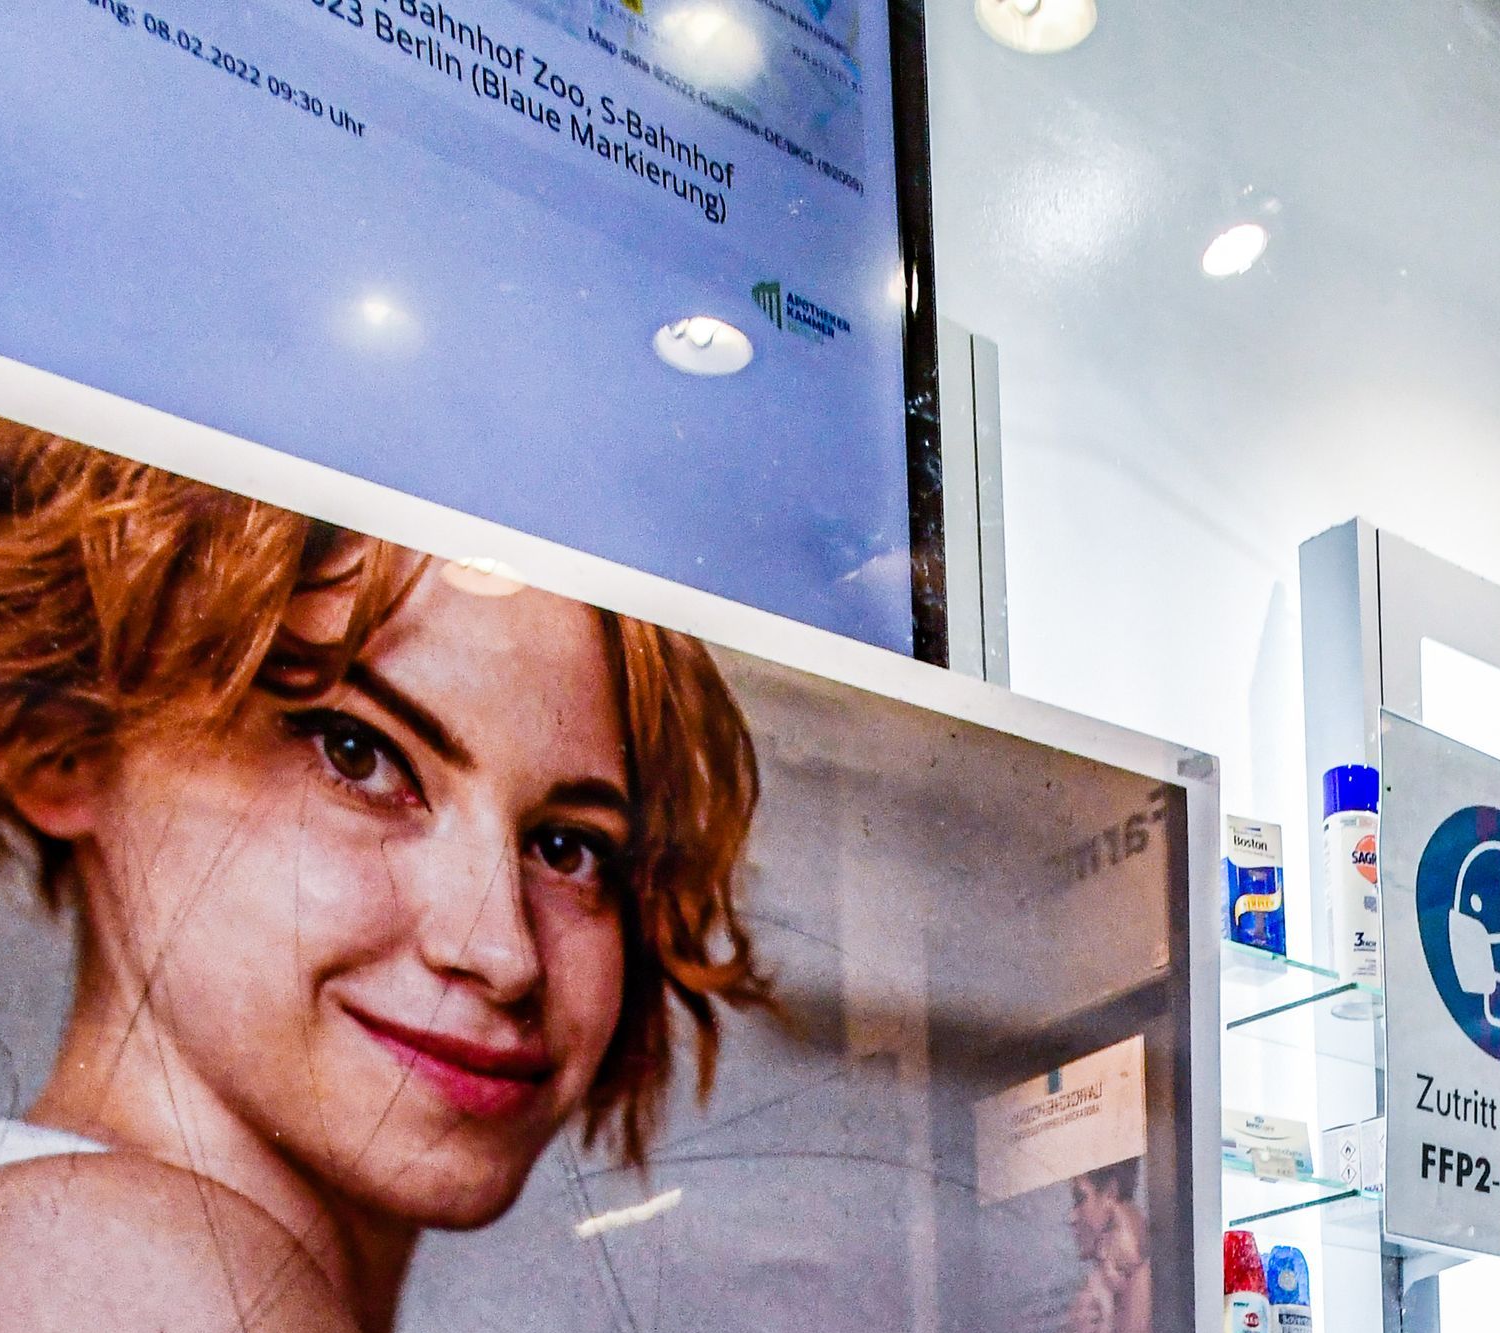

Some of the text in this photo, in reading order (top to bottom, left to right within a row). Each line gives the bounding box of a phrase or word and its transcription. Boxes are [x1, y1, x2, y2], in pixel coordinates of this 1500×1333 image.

[143, 12, 261, 88] 08.02.2022
[267, 75, 323, 117] 09:30
[329, 105, 365, 138] Uhr
[375, 11, 463, 82] Berlin
[471, 61, 562, 132] (Blaue
[570, 112, 727, 225] Markierung)
[532, 56, 594, 118] Zoo,
[600, 97, 735, 189] S-Bahnhof
[1233, 834, 1269, 852] Boston
[1415, 1072, 1498, 1131] Zutritt
